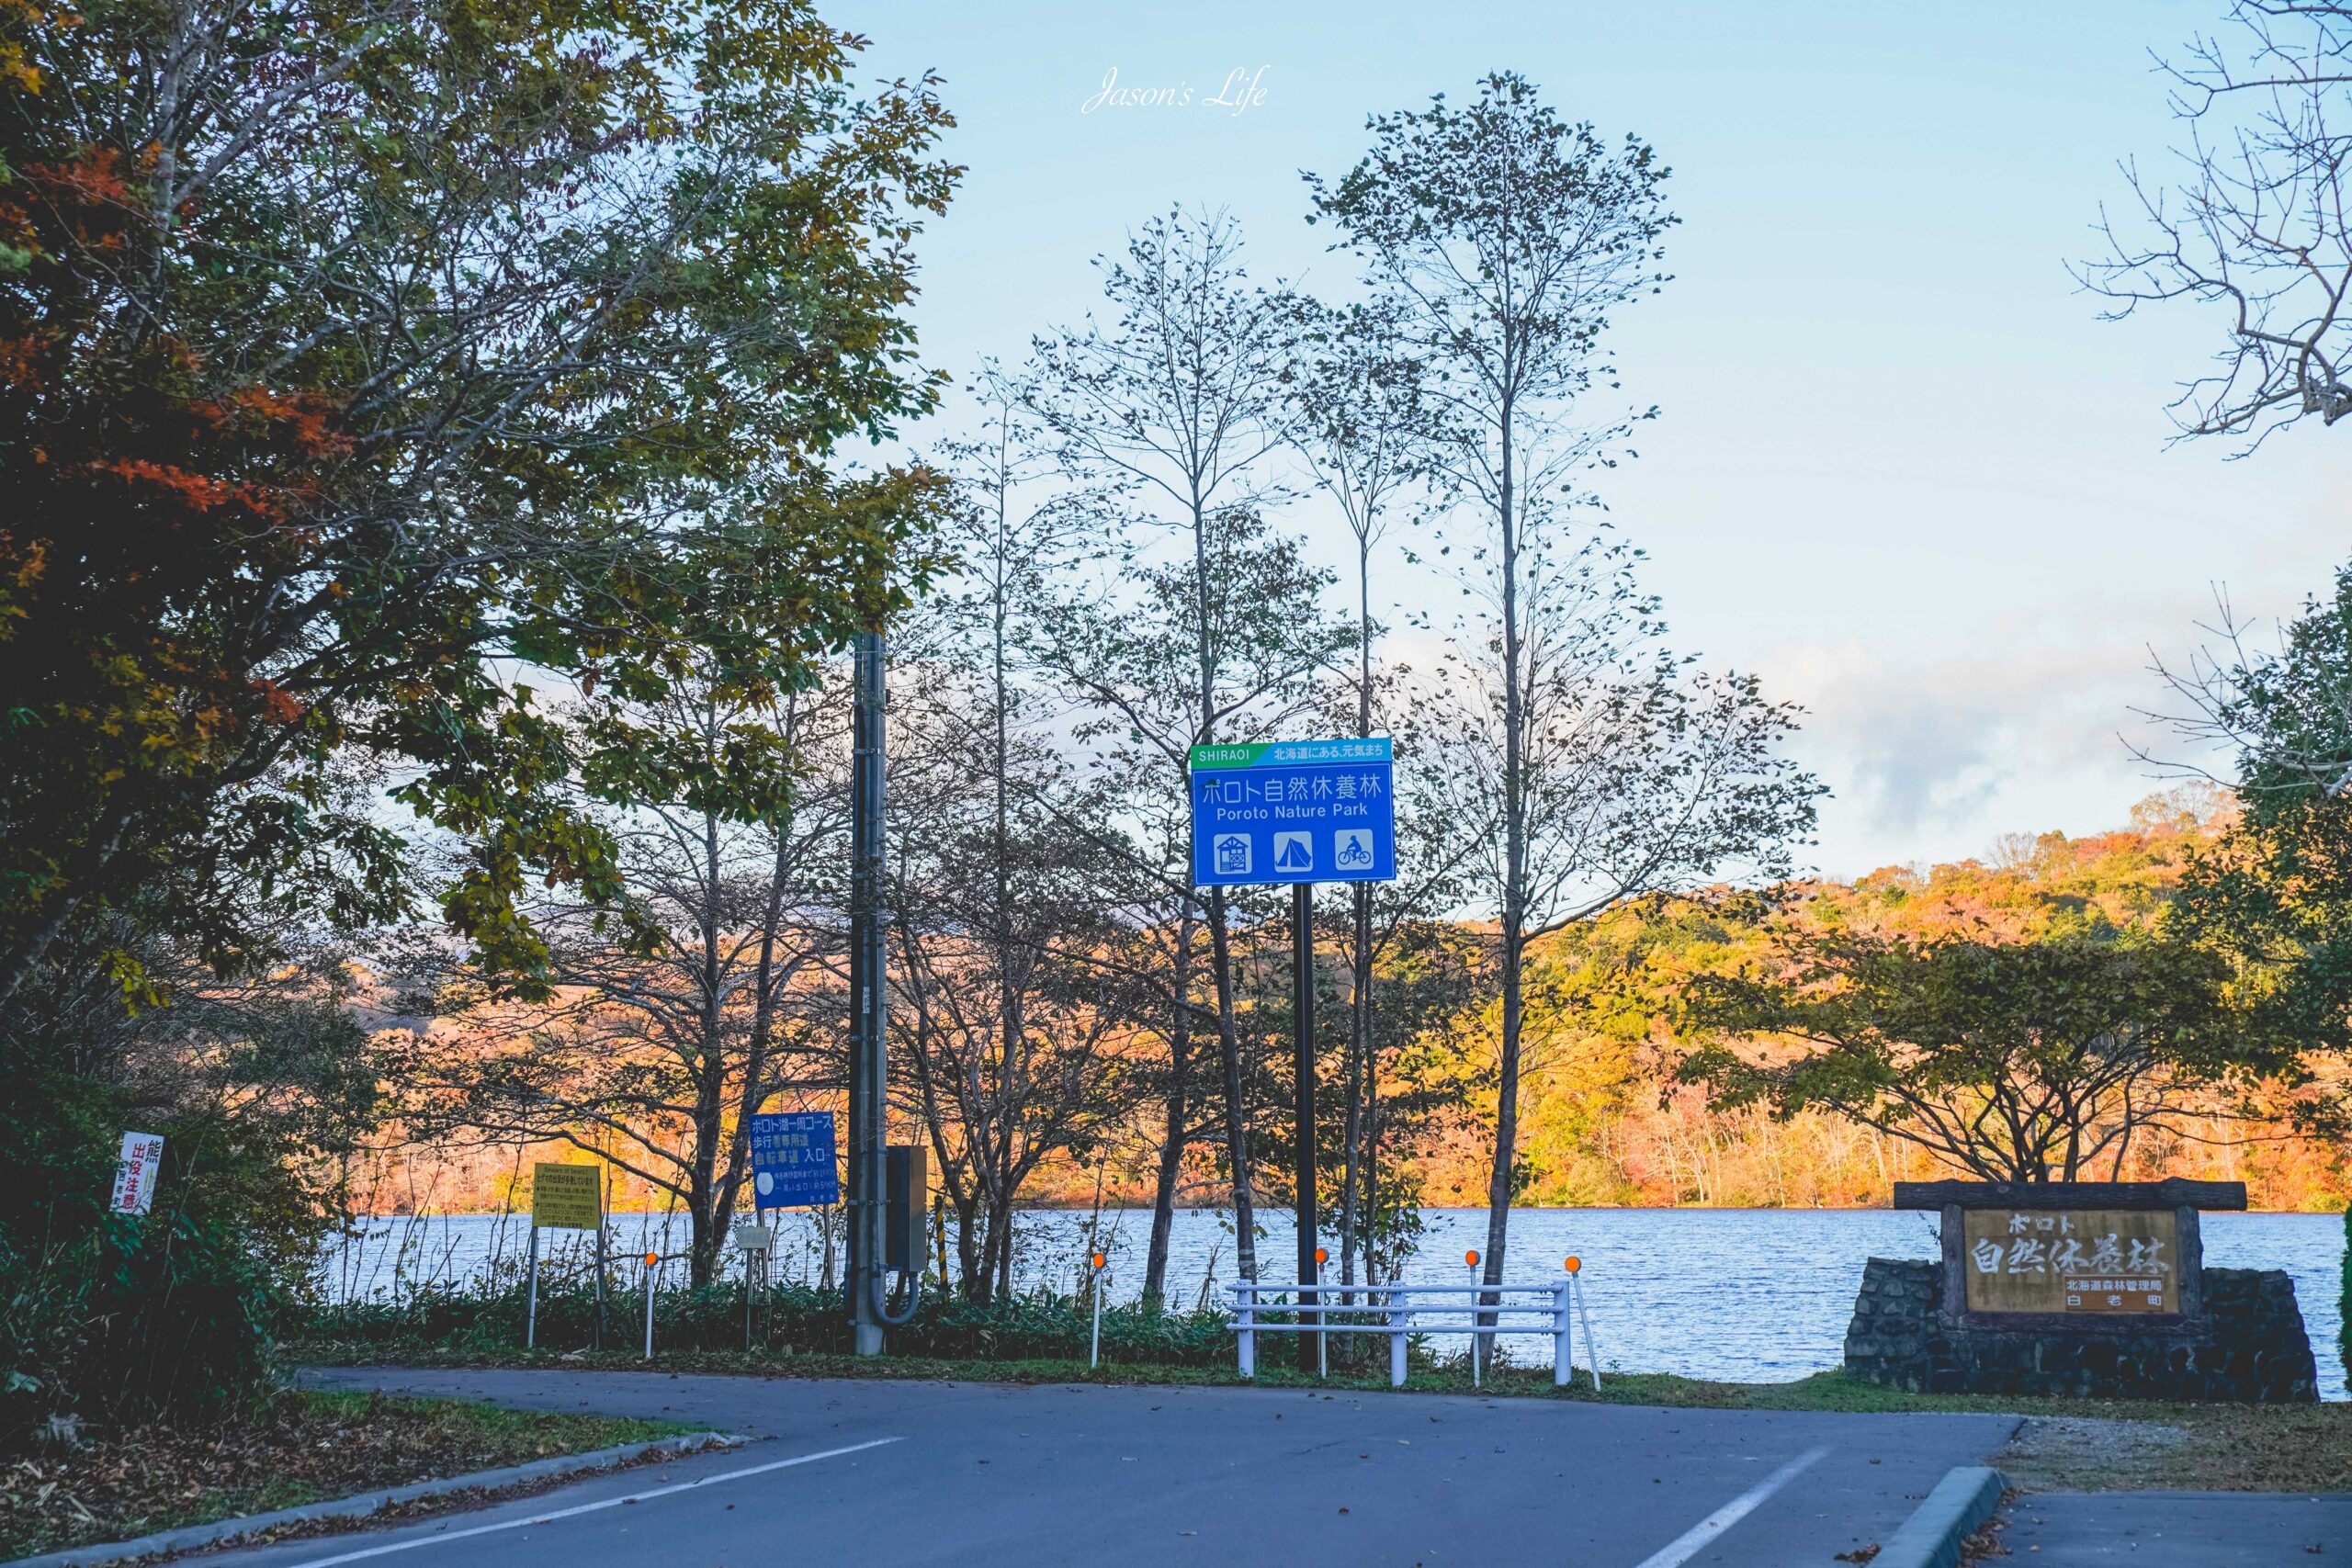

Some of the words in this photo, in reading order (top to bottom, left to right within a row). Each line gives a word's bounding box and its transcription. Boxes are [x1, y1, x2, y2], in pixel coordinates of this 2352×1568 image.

[1199, 750, 1250, 761] SHIRAOI
[1203, 773, 1382, 805] ポロト自然休養林
[1217, 807, 1268, 820] Poroto
[1275, 806, 1326, 818] Nature
[1333, 803, 1368, 816] Park
[144, 1140, 162, 1164] 熊
[804, 1148, 824, 1162] 入口
[123, 1143, 146, 1210] 出没注意
[2008, 1213, 2075, 1235] ポロト
[1971, 1233, 2171, 1275] 自然休養林
[2066, 1280, 2162, 1292] 北海道森林管理局
